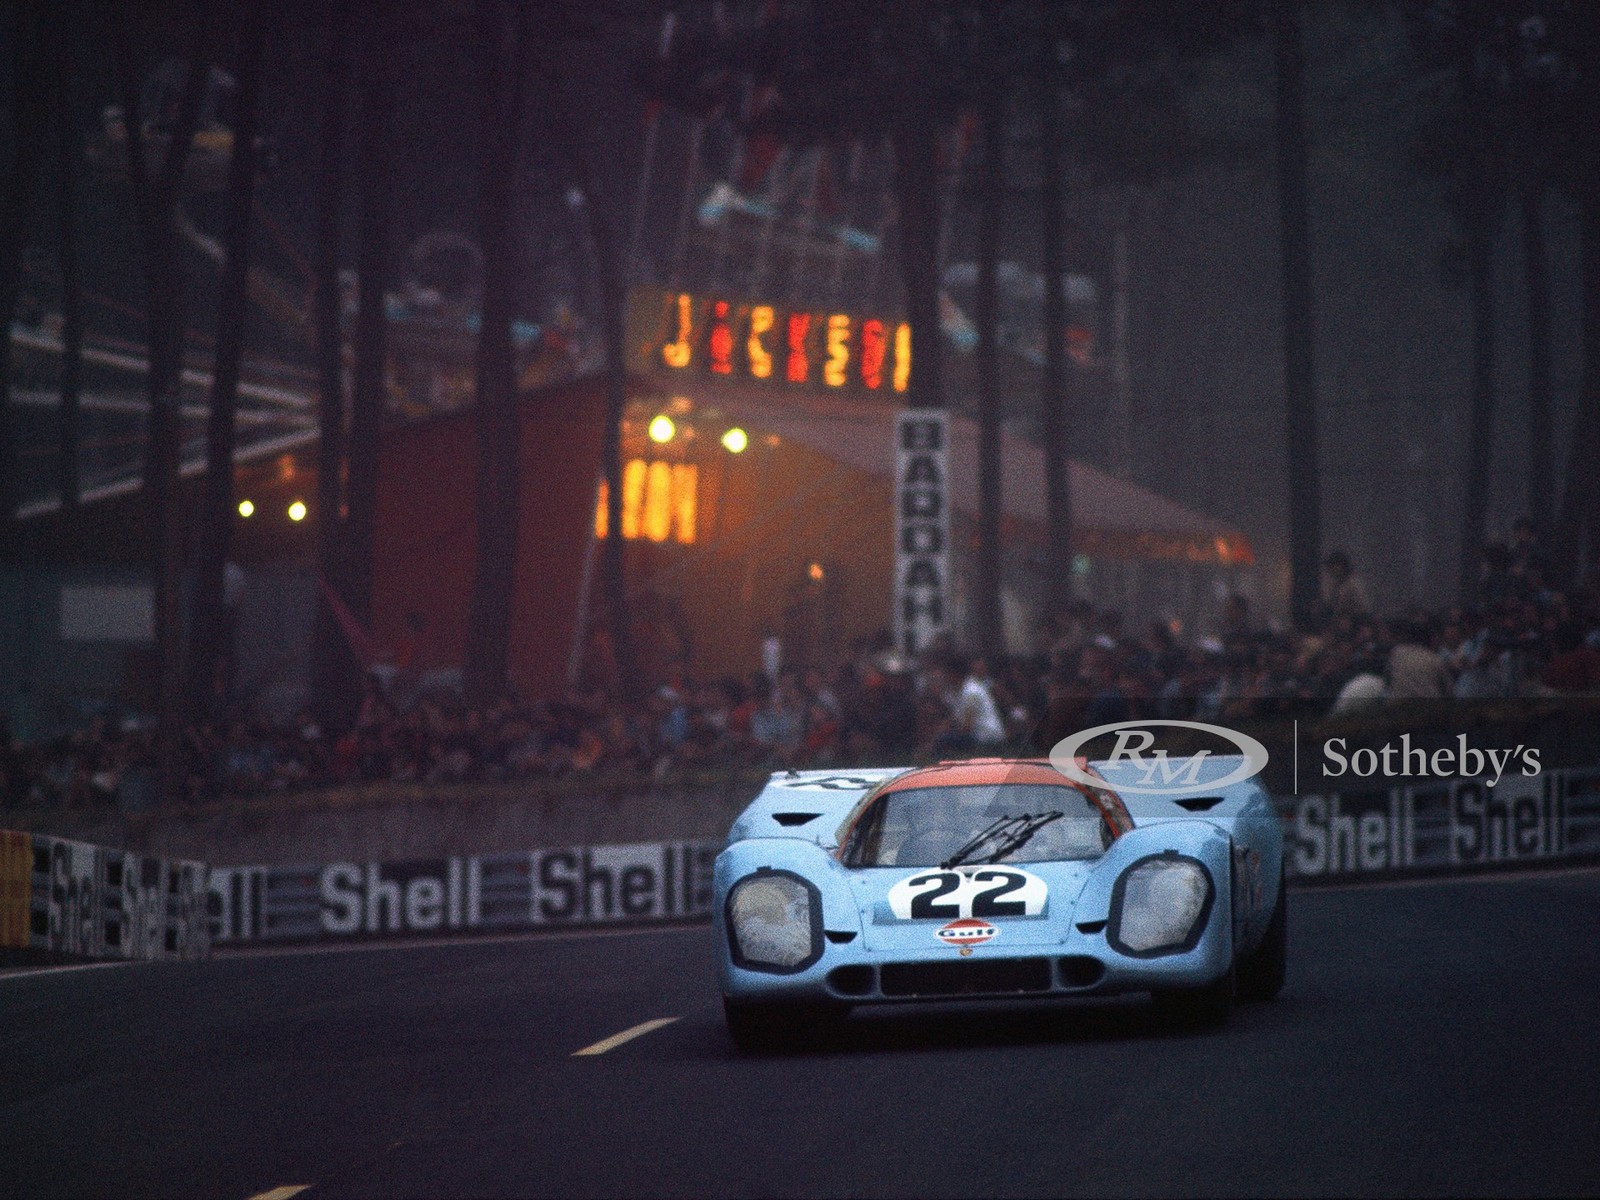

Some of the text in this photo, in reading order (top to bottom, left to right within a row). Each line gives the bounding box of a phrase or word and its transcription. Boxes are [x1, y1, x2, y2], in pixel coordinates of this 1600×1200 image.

[1294, 787, 1414, 876] Shell
[1455, 771, 1564, 860] Shell
[320, 857, 481, 934] Shell
[538, 847, 693, 920] Shell
[908, 871, 1027, 919] 22
[937, 926, 997, 938] Gulf
